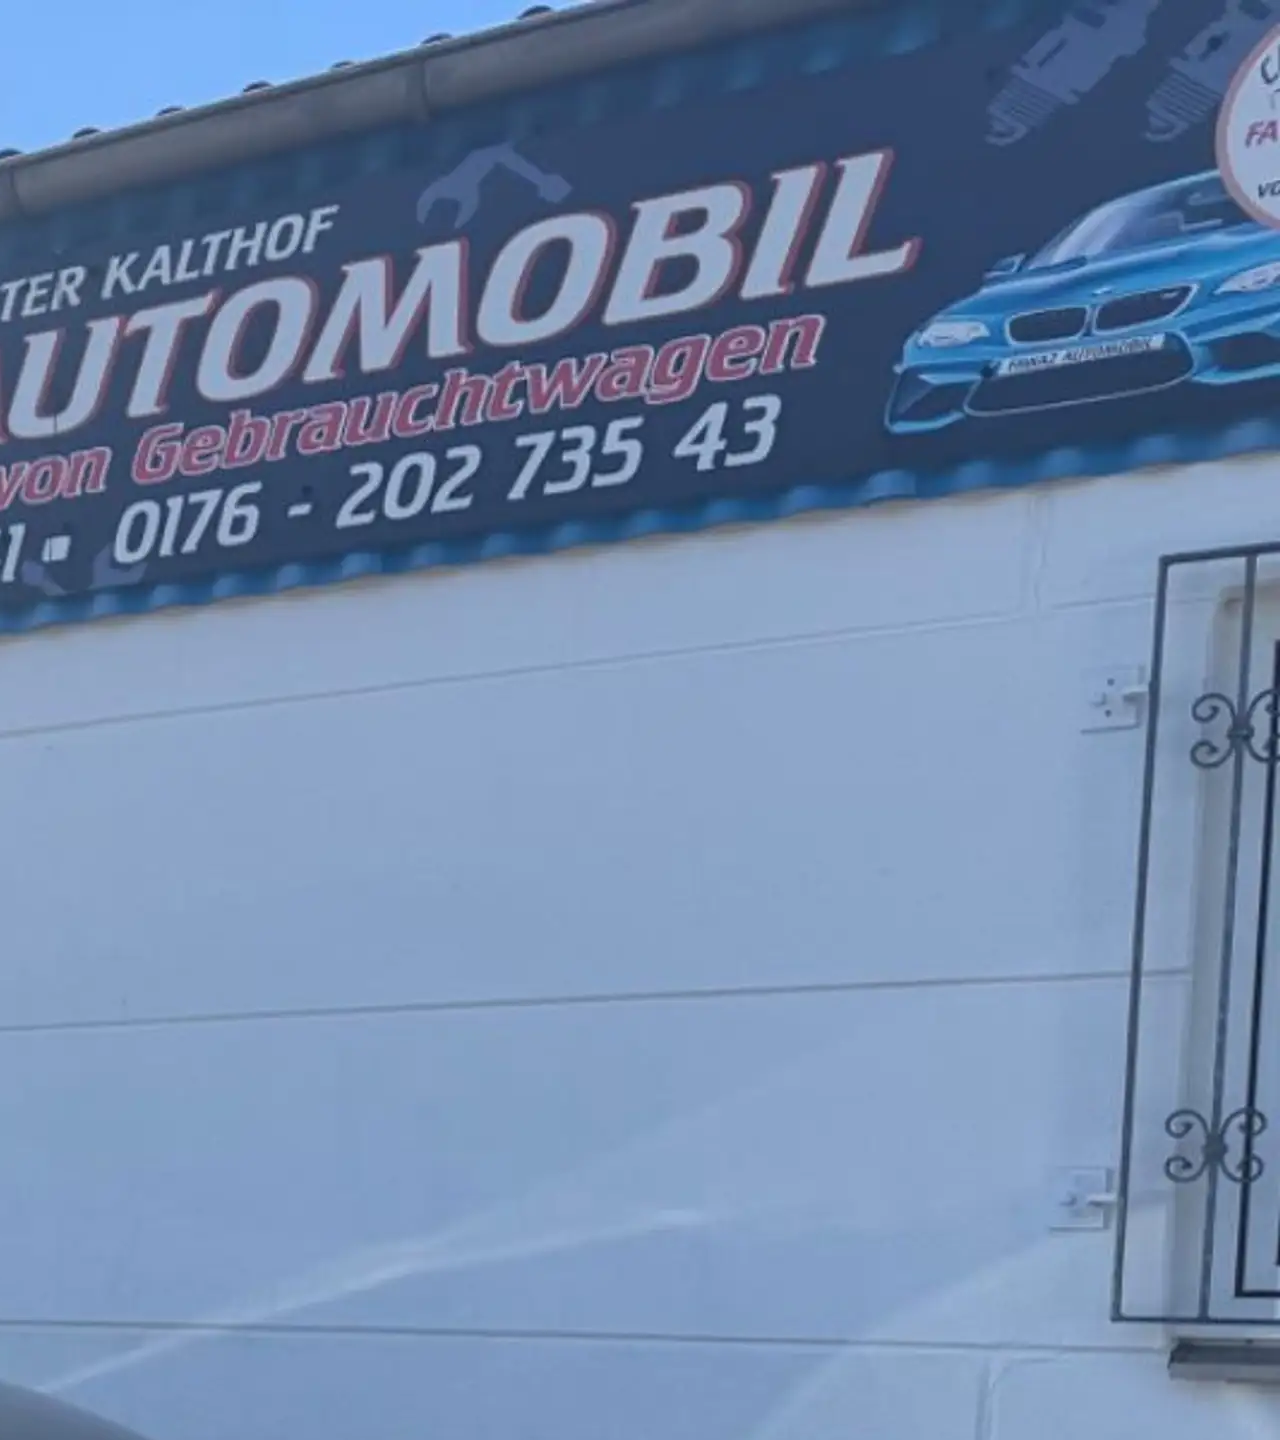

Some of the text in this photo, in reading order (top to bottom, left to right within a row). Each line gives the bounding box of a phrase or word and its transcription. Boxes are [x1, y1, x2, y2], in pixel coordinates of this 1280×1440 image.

[102, 205, 340, 301] KALTHOF
[114, 481, 262, 565] 0176
[335, 444, 481, 528] 202
[507, 416, 646, 500] 735
[674, 394, 782, 472] 43
[133, 312, 826, 485] Gebrauchtwagen
